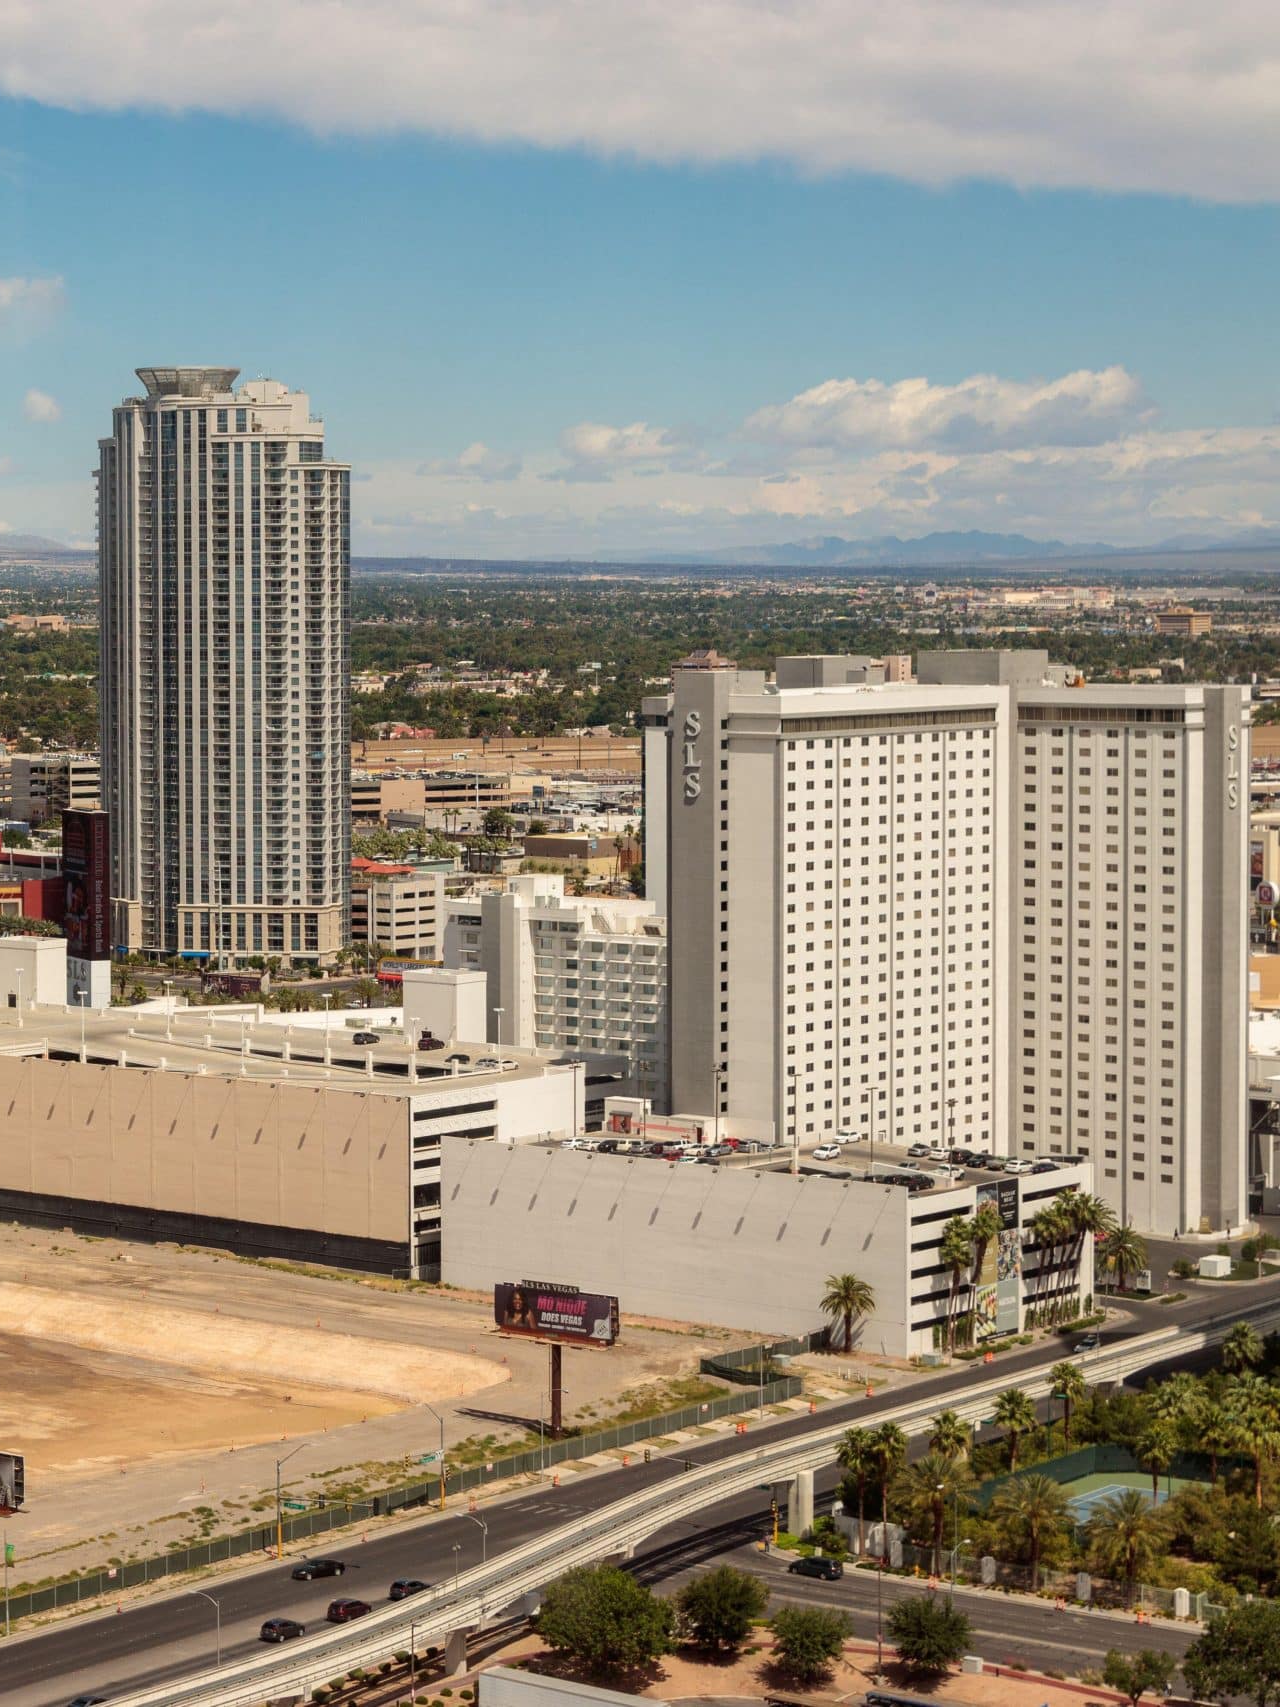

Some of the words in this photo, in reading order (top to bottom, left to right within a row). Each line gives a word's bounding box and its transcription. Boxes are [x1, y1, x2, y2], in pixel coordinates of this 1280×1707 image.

[684, 711, 702, 798] SLS
[1227, 724, 1238, 809] SLS
[95, 879, 103, 892] Beer
[93, 920, 103, 938] Sports
[521, 1280, 535, 1289] SLS
[536, 1283, 551, 1291] LAS
[552, 1284, 578, 1294] VEGAS
[541, 1311, 559, 1323] DOES
[560, 1313, 583, 1326] VEGAS
